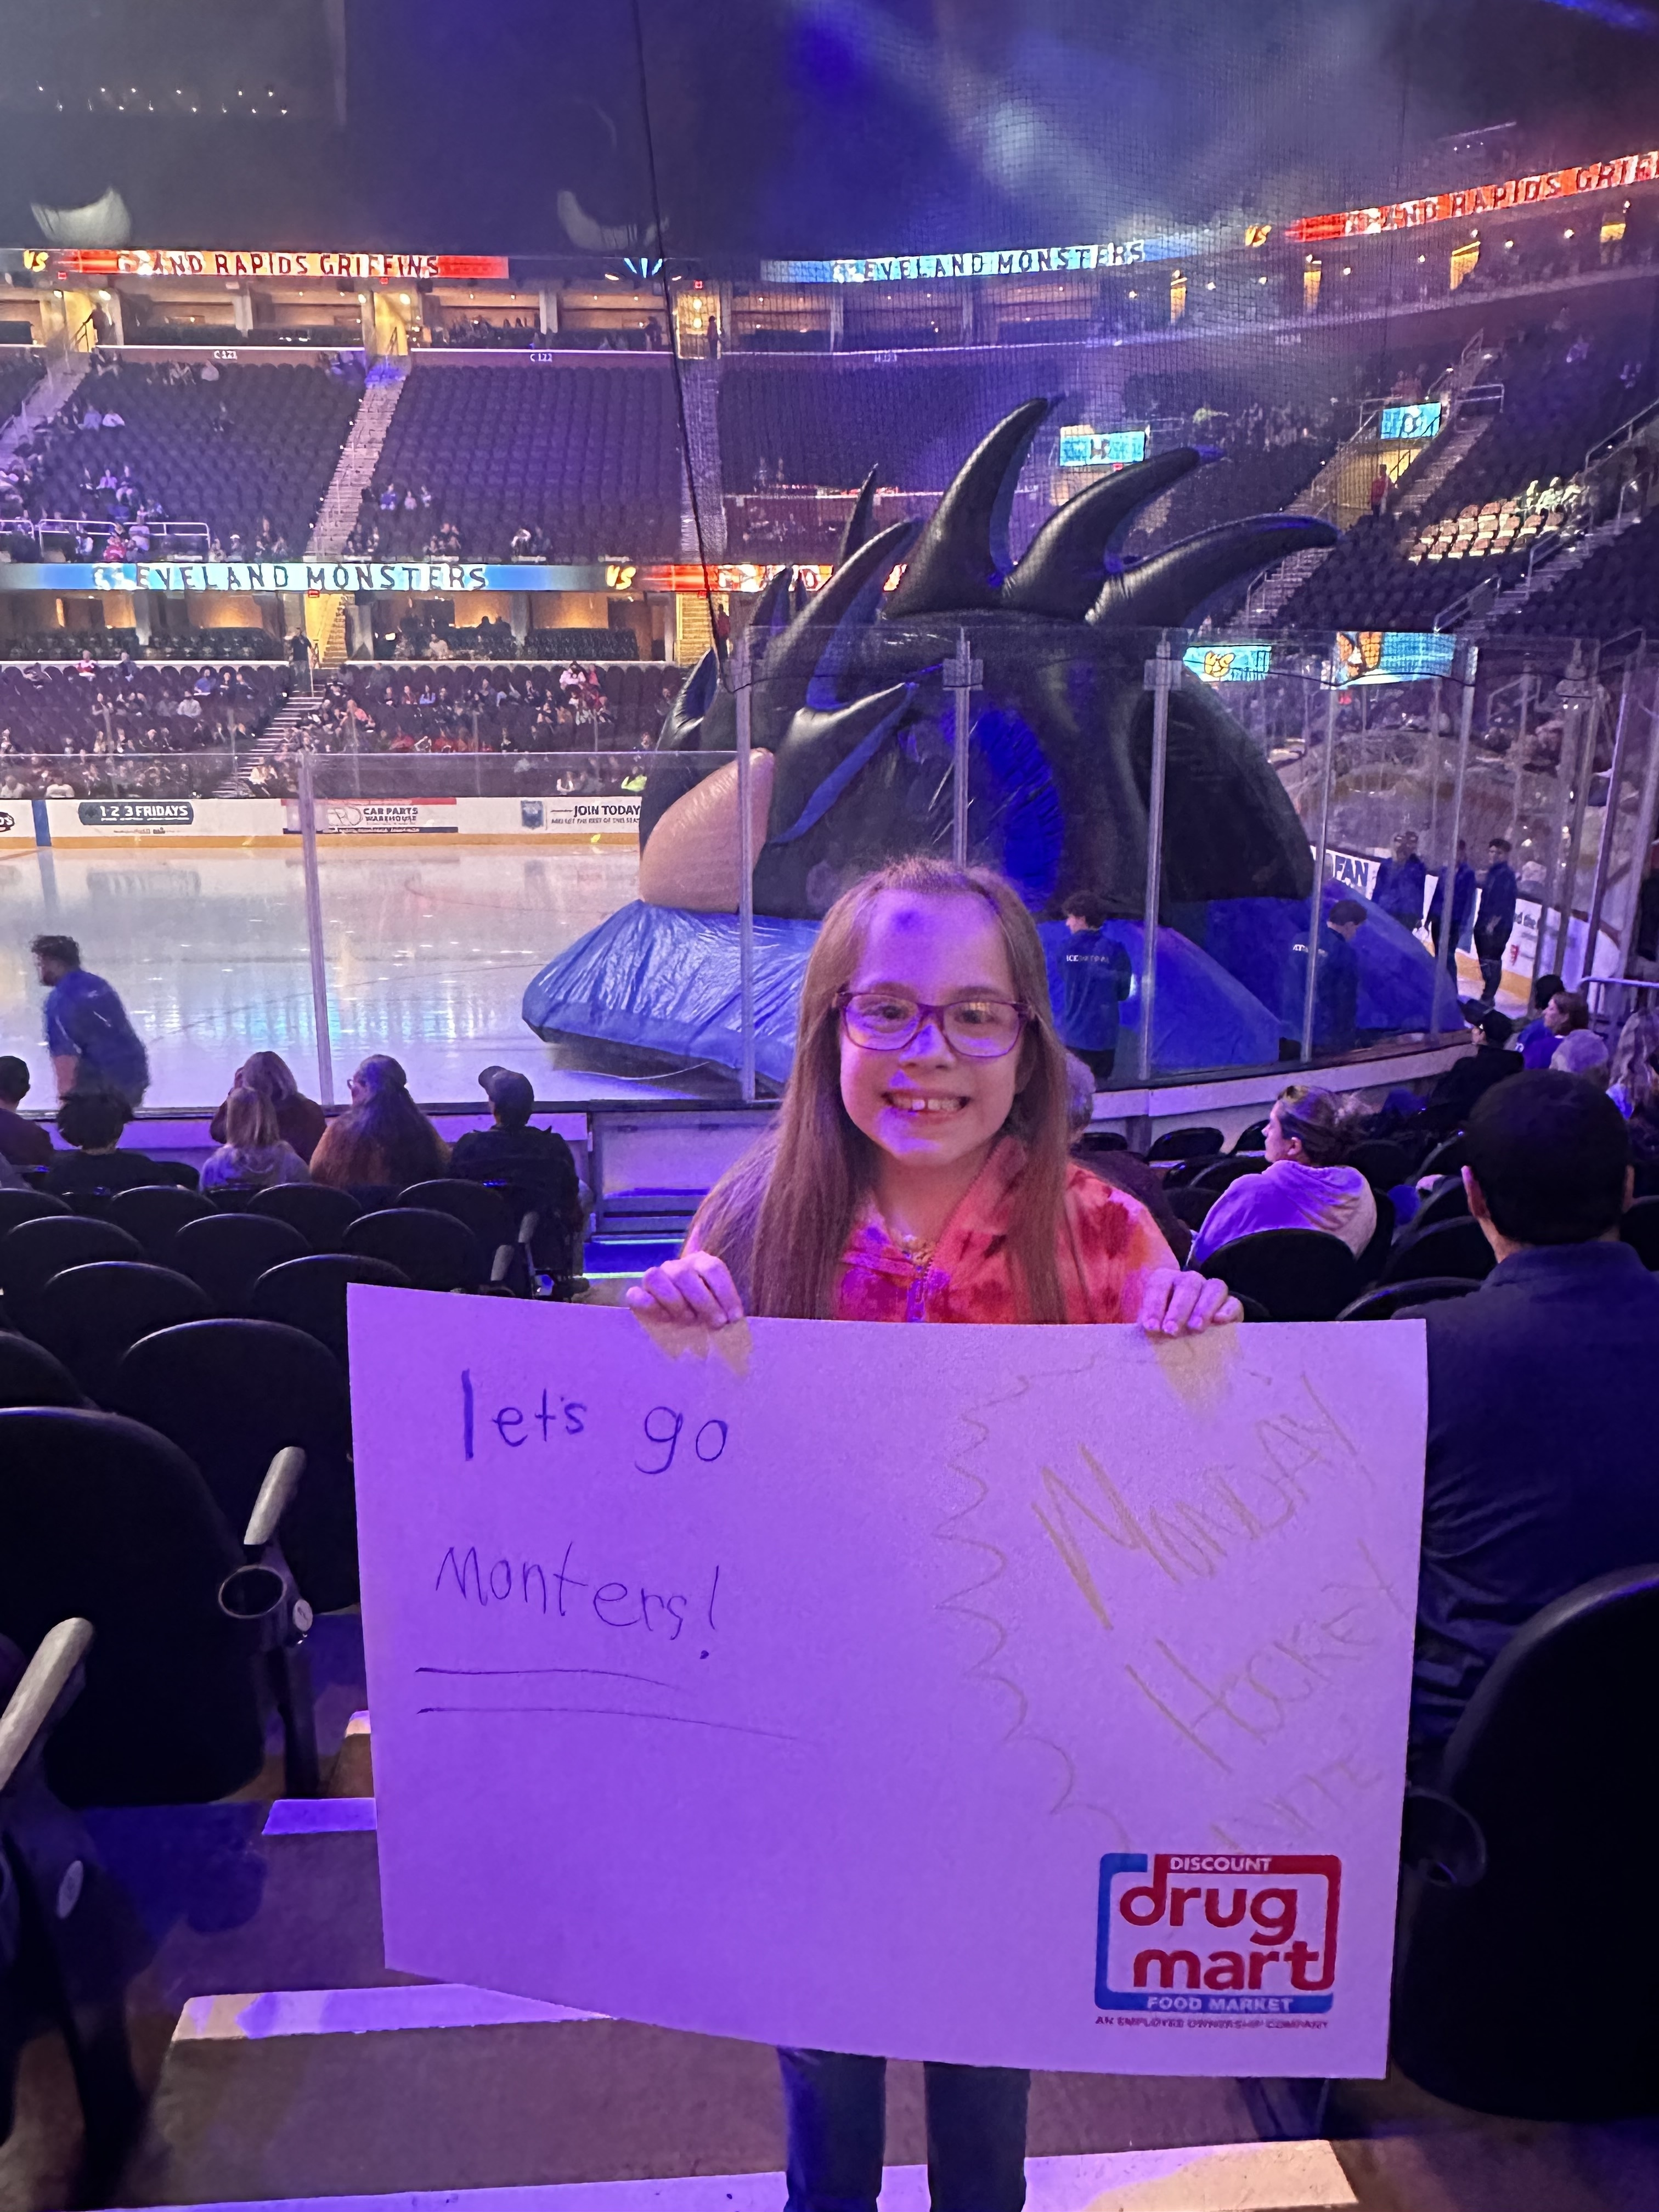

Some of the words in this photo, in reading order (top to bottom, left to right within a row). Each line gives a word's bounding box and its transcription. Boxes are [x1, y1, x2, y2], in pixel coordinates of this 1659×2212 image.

[1245, 224, 1272, 247] VS
[23, 249, 49, 272] VS
[116, 251, 203, 275] GAND
[215, 252, 308, 275] RAPIDS
[320, 253, 439, 277] GRIFFINS
[998, 242, 1144, 273] MONSTERS
[307, 564, 486, 590] MONSTERS
[605, 564, 636, 590] VS
[135, 806, 188, 817] FRIDAYS
[574, 805, 599, 818] JOIN
[601, 805, 641, 815] TODAY
[1335, 855, 1369, 887] FAN
[634, 1406, 729, 1474] go
[1170, 1857, 1272, 1871] DISCOUNT
[1120, 1882, 1298, 1945] drug
[1133, 1940, 1319, 1991] mart
[1148, 1996, 1202, 2010] FOOD
[1209, 1997, 1293, 2011] MARKET
